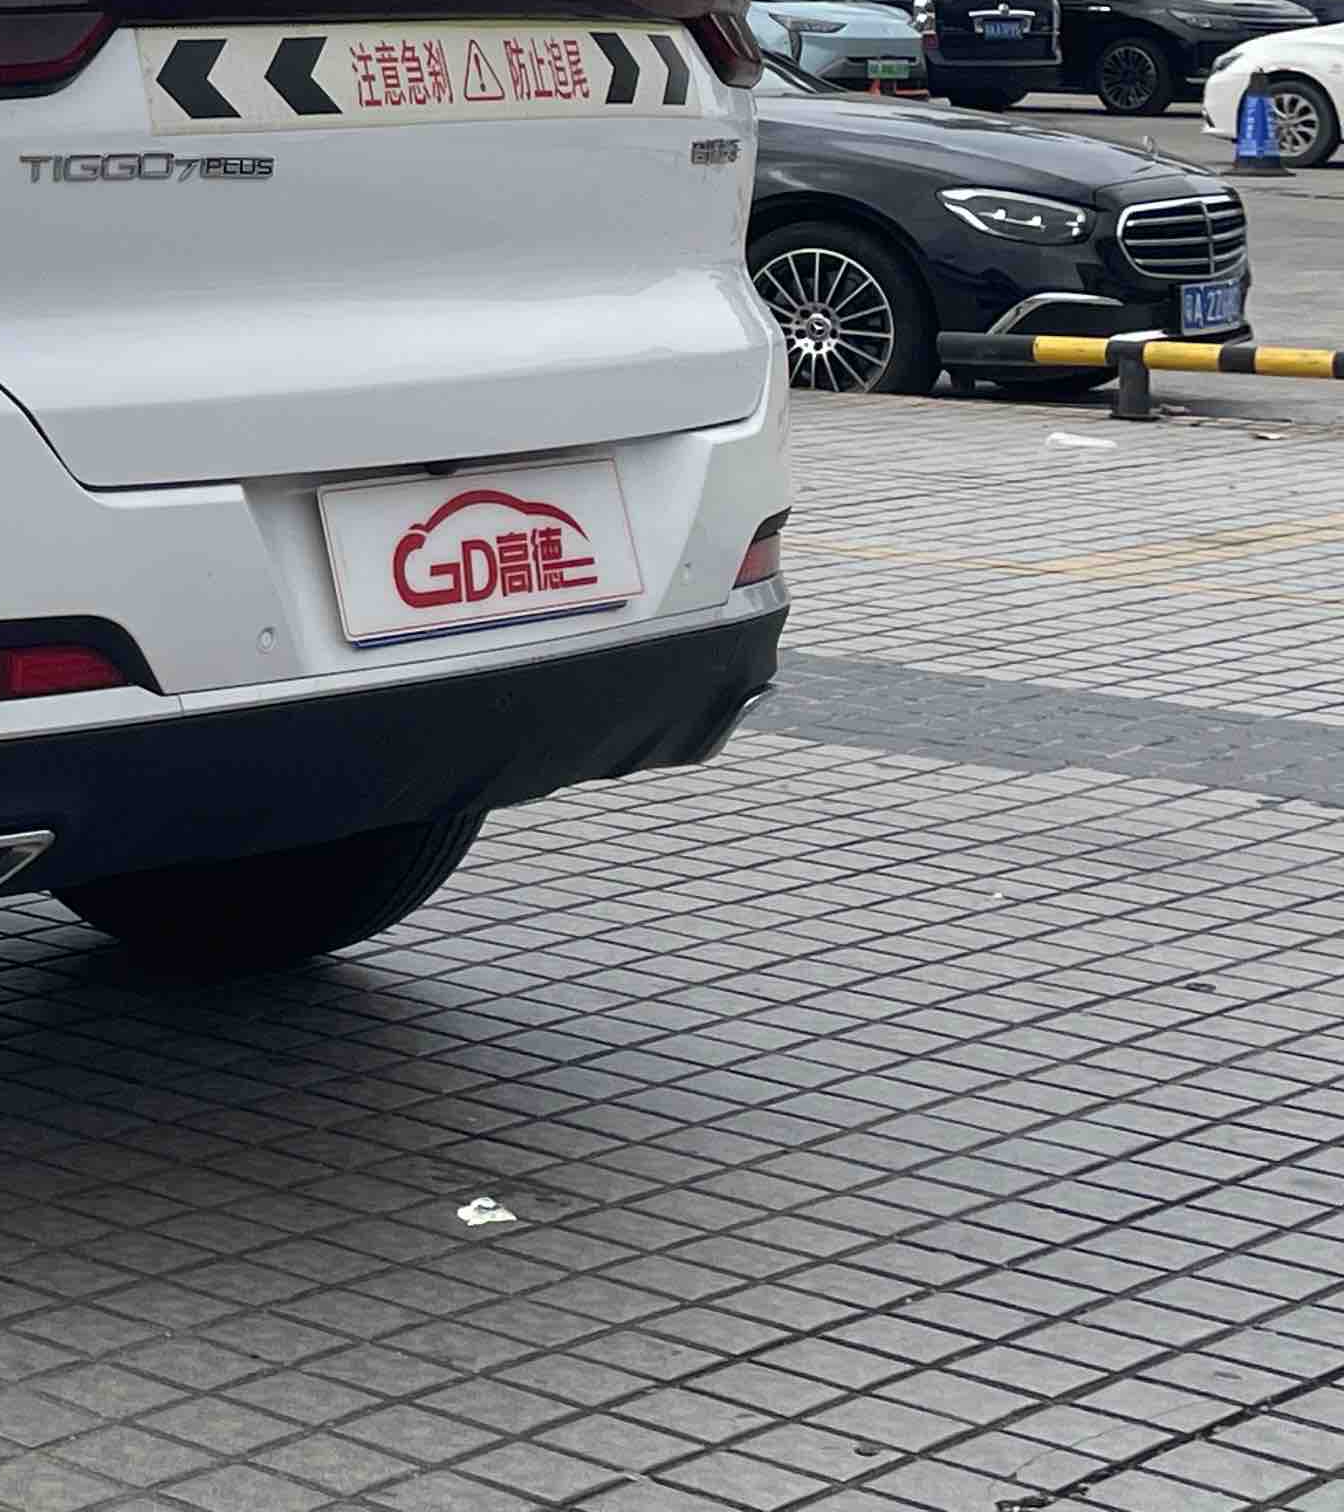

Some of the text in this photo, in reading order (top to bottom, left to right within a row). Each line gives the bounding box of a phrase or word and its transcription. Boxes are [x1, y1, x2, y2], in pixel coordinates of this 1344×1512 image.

[349, 36, 592, 108] 注意急刹 防止追尾
